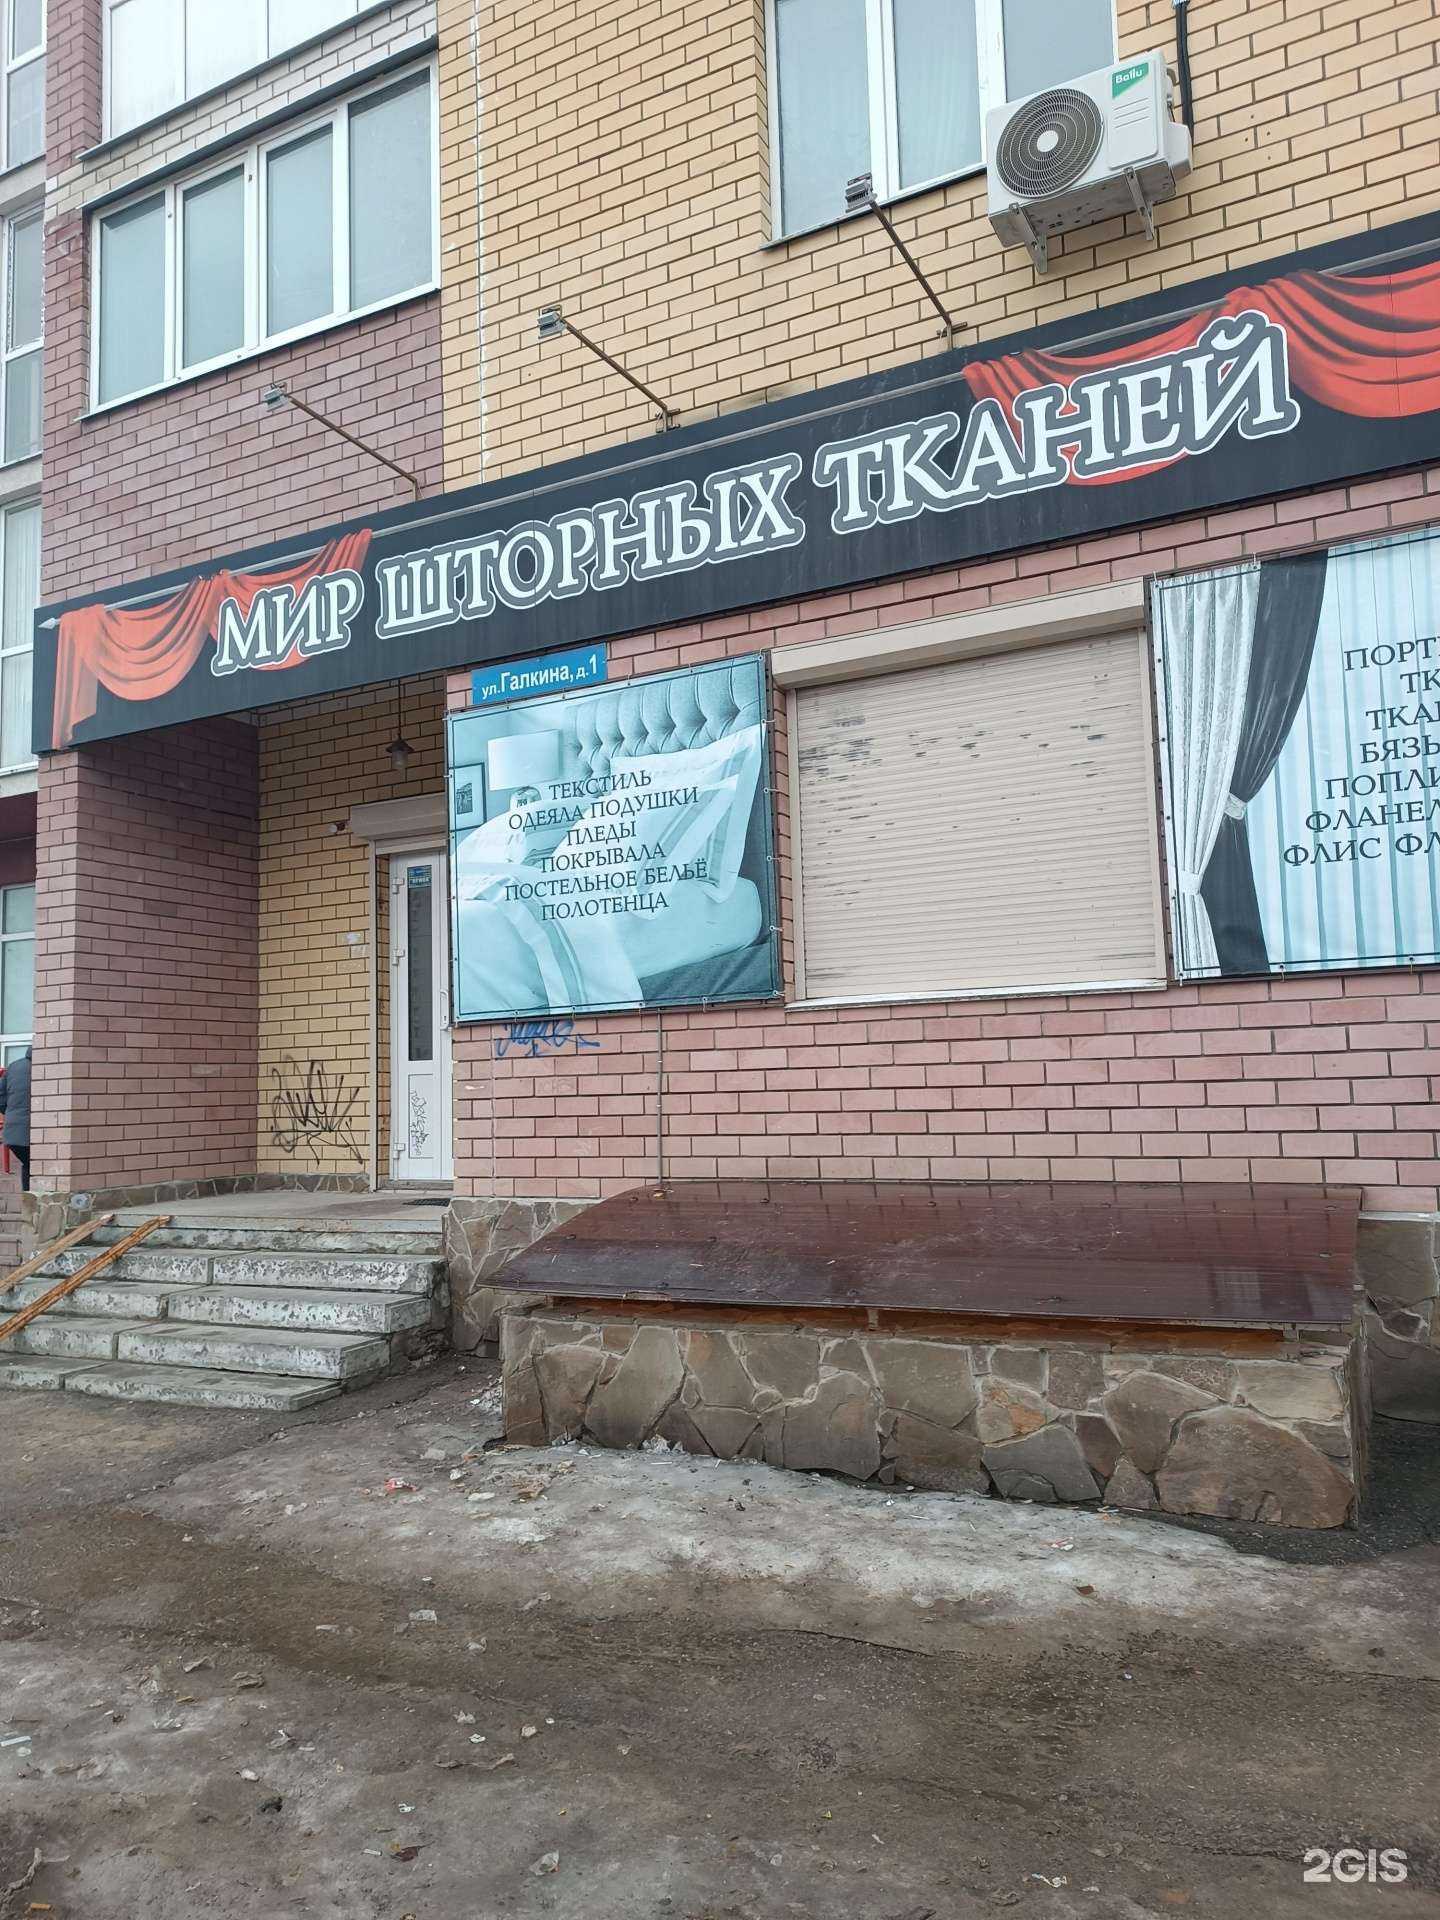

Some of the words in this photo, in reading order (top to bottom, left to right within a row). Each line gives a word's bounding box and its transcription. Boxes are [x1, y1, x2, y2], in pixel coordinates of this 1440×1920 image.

[1115, 68, 1143, 84] Ballu
[214, 573, 361, 671] МИР
[379, 459, 800, 634] ШТОРНЫХ
[819, 316, 1293, 528] ТКАНЕЙ
[1344, 636, 1440, 671] ПОРТ
[1366, 701, 1440, 730] ТКА
[1360, 735, 1440, 764] БЯЗЬ
[549, 770, 652, 801] ТЕКСТИЛЬ
[508, 806, 583, 831] ОДЕЯЛА
[590, 786, 699, 820] ПОДУШКИ
[566, 821, 637, 847] ПЛЕДЫ
[541, 842, 665, 873] ПОКРЫВАЛА
[1283, 837, 1382, 867] ФЛИС
[504, 868, 638, 901] ПОСТЕЛЬНОЕ
[644, 857, 708, 885] БЕЛЬЁ
[541, 893, 669, 921] ПОЛОТЕНЦА
